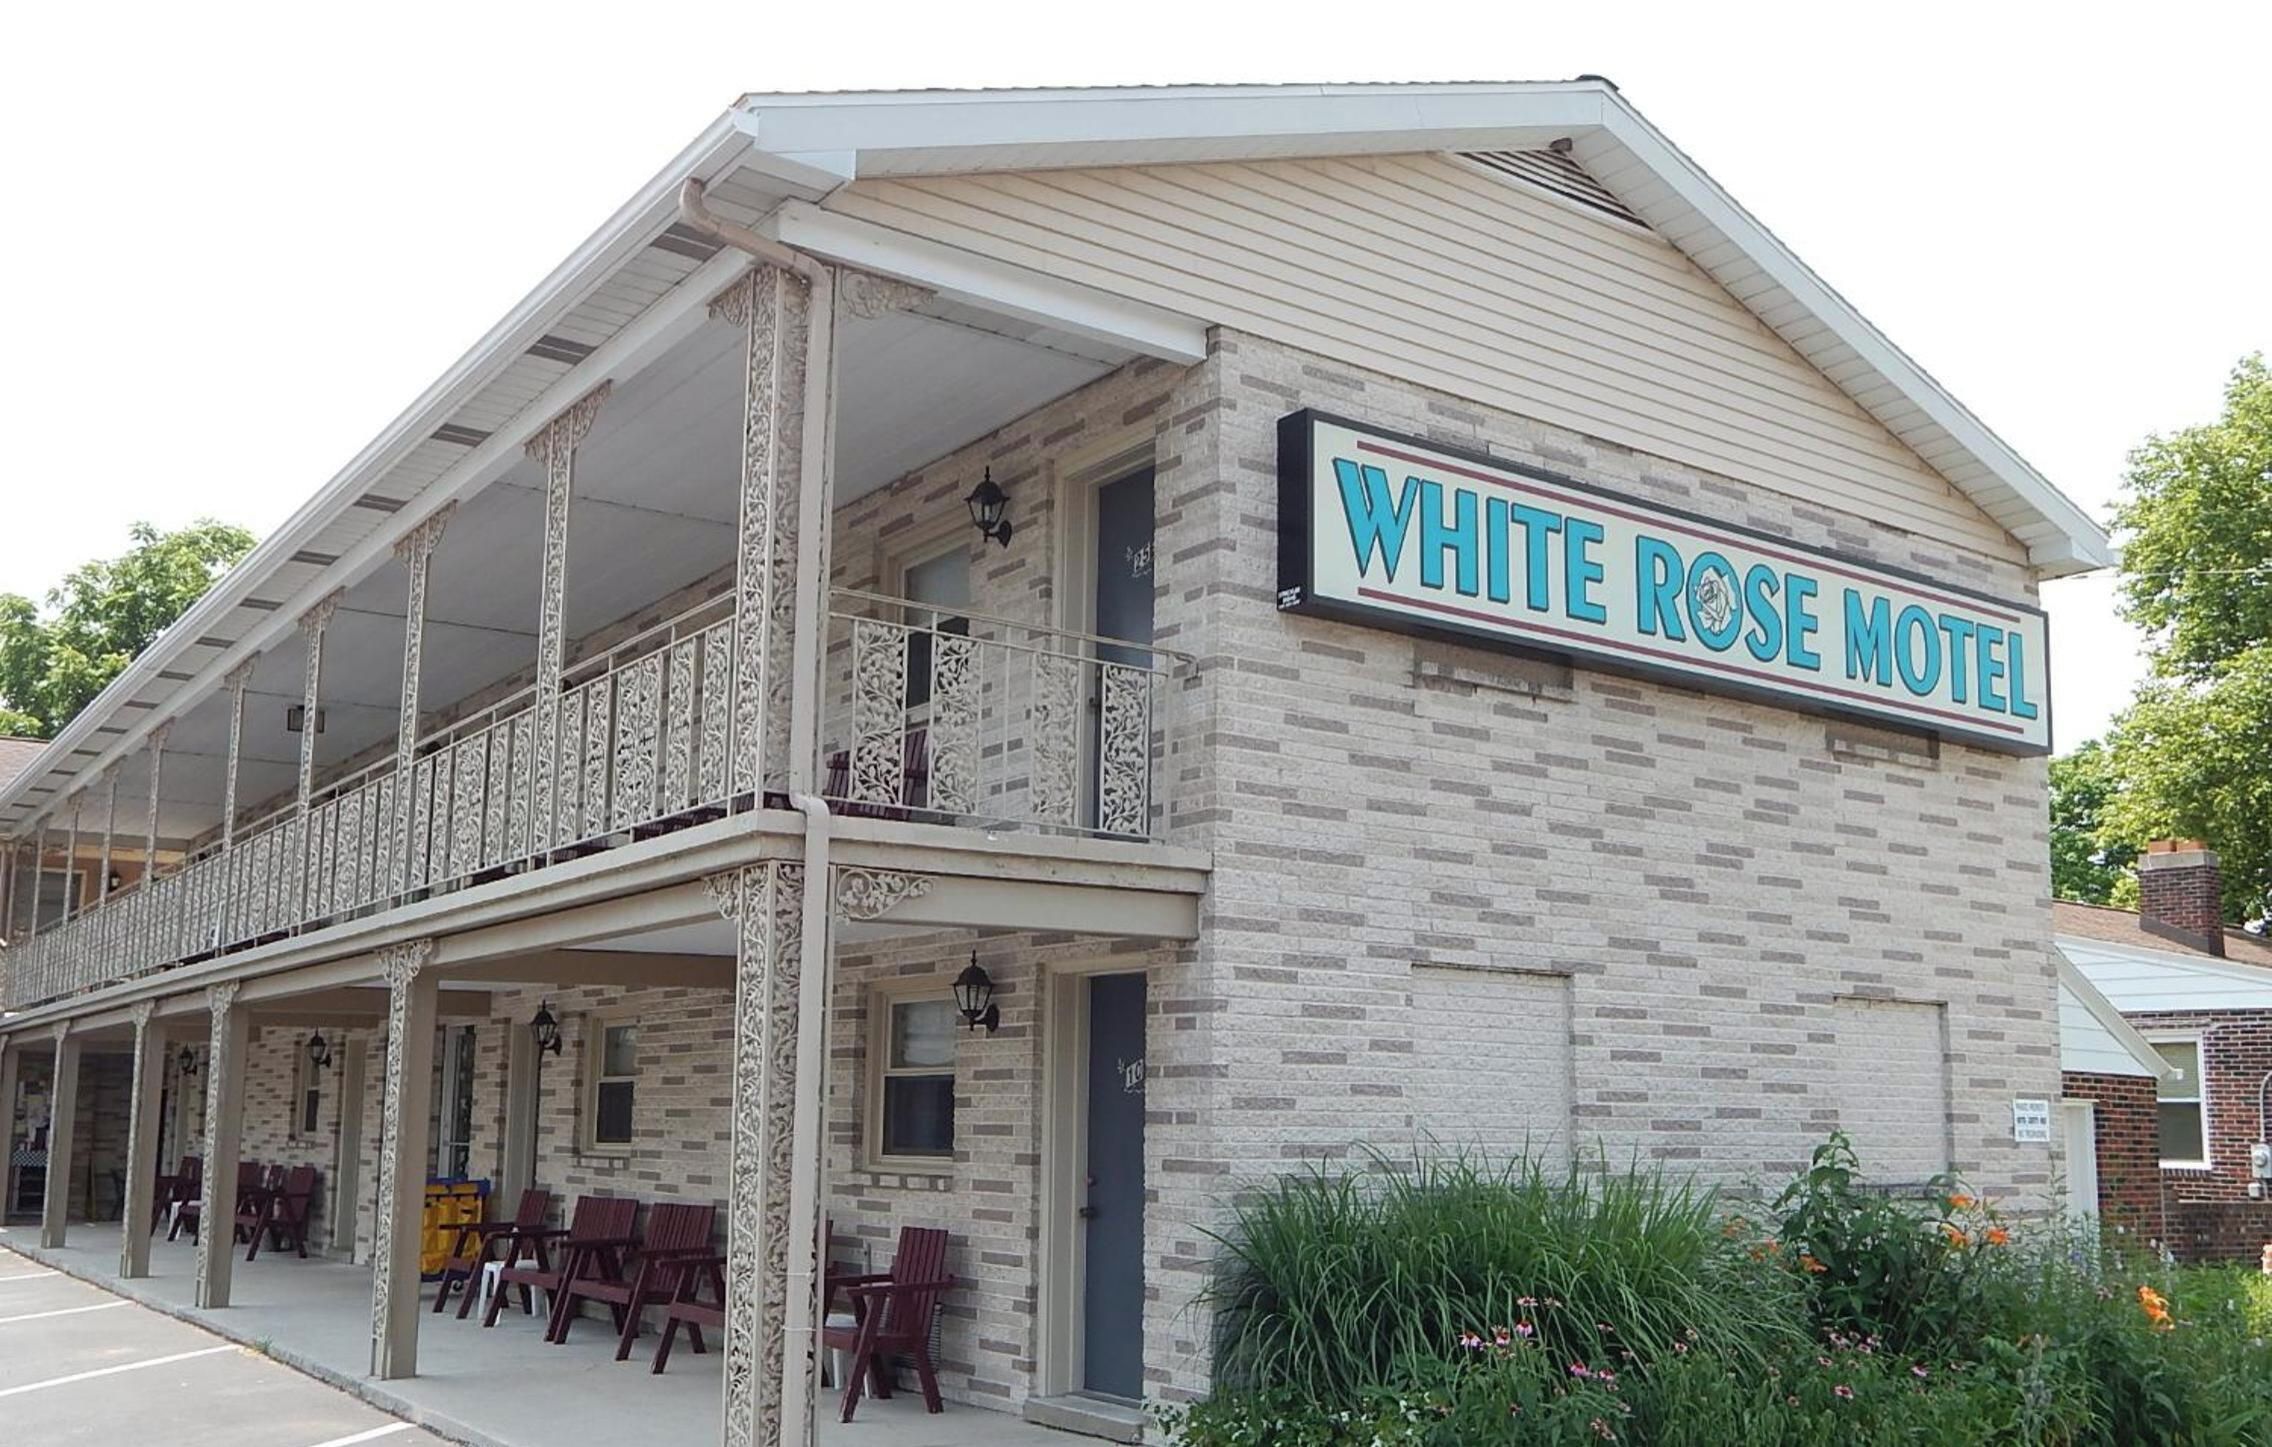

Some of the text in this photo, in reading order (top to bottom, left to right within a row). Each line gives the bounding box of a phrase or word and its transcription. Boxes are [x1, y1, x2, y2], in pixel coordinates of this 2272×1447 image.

[1332, 457, 2039, 720] WHITE ROSE MOTEL
